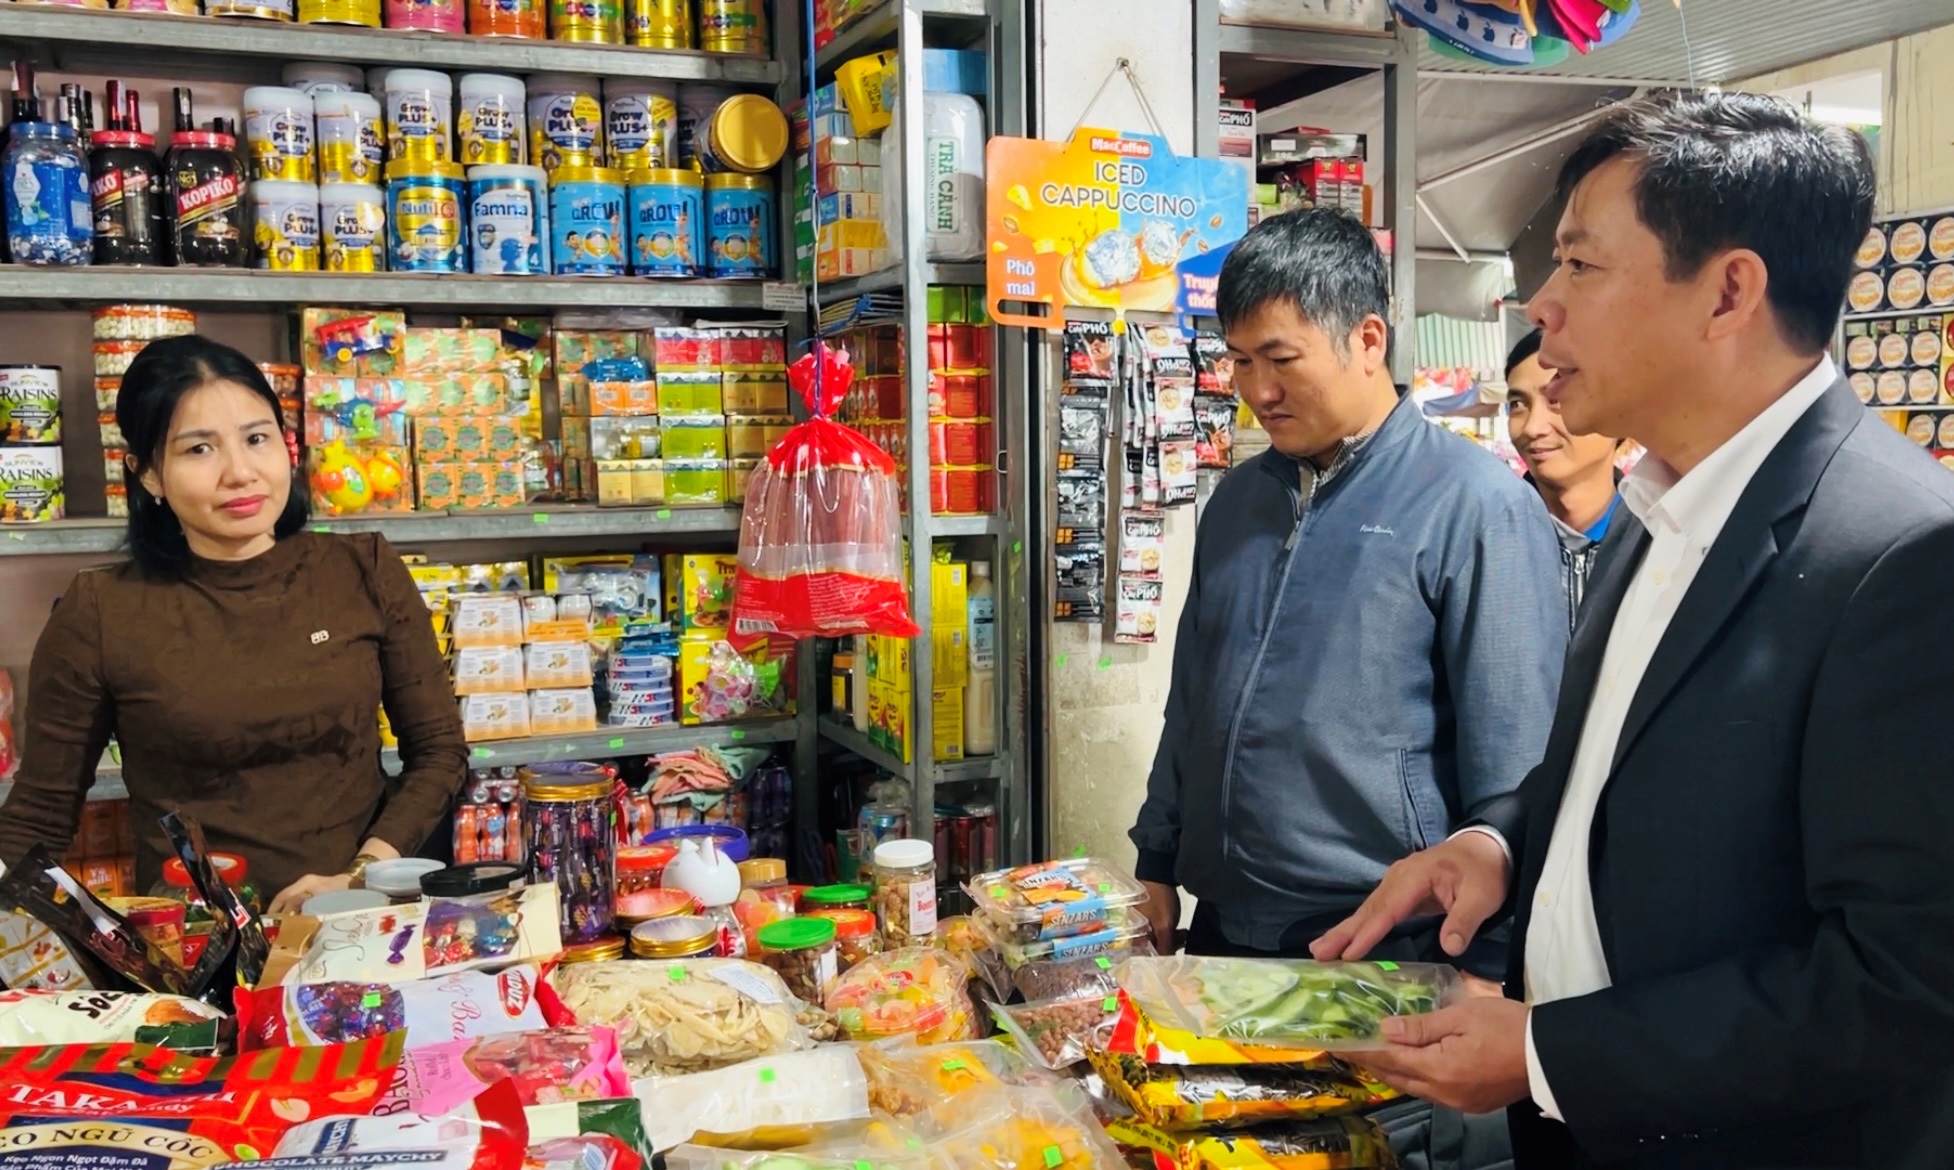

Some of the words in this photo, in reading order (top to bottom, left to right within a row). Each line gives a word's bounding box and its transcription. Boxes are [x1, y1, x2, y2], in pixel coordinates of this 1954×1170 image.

[1091, 138, 1150, 155] MacCoffee
[1095, 161, 1146, 186] ICED
[180, 176, 235, 210] KOPIKO
[1041, 184, 1196, 218] CAPPUCCINO
[474, 202, 528, 216] Famna
[530, 254, 540, 266] 4
[1007, 281, 1035, 297] mai
[2, 387, 58, 404] RAISINS
[347, 1153, 443, 1165] MAYCHY
